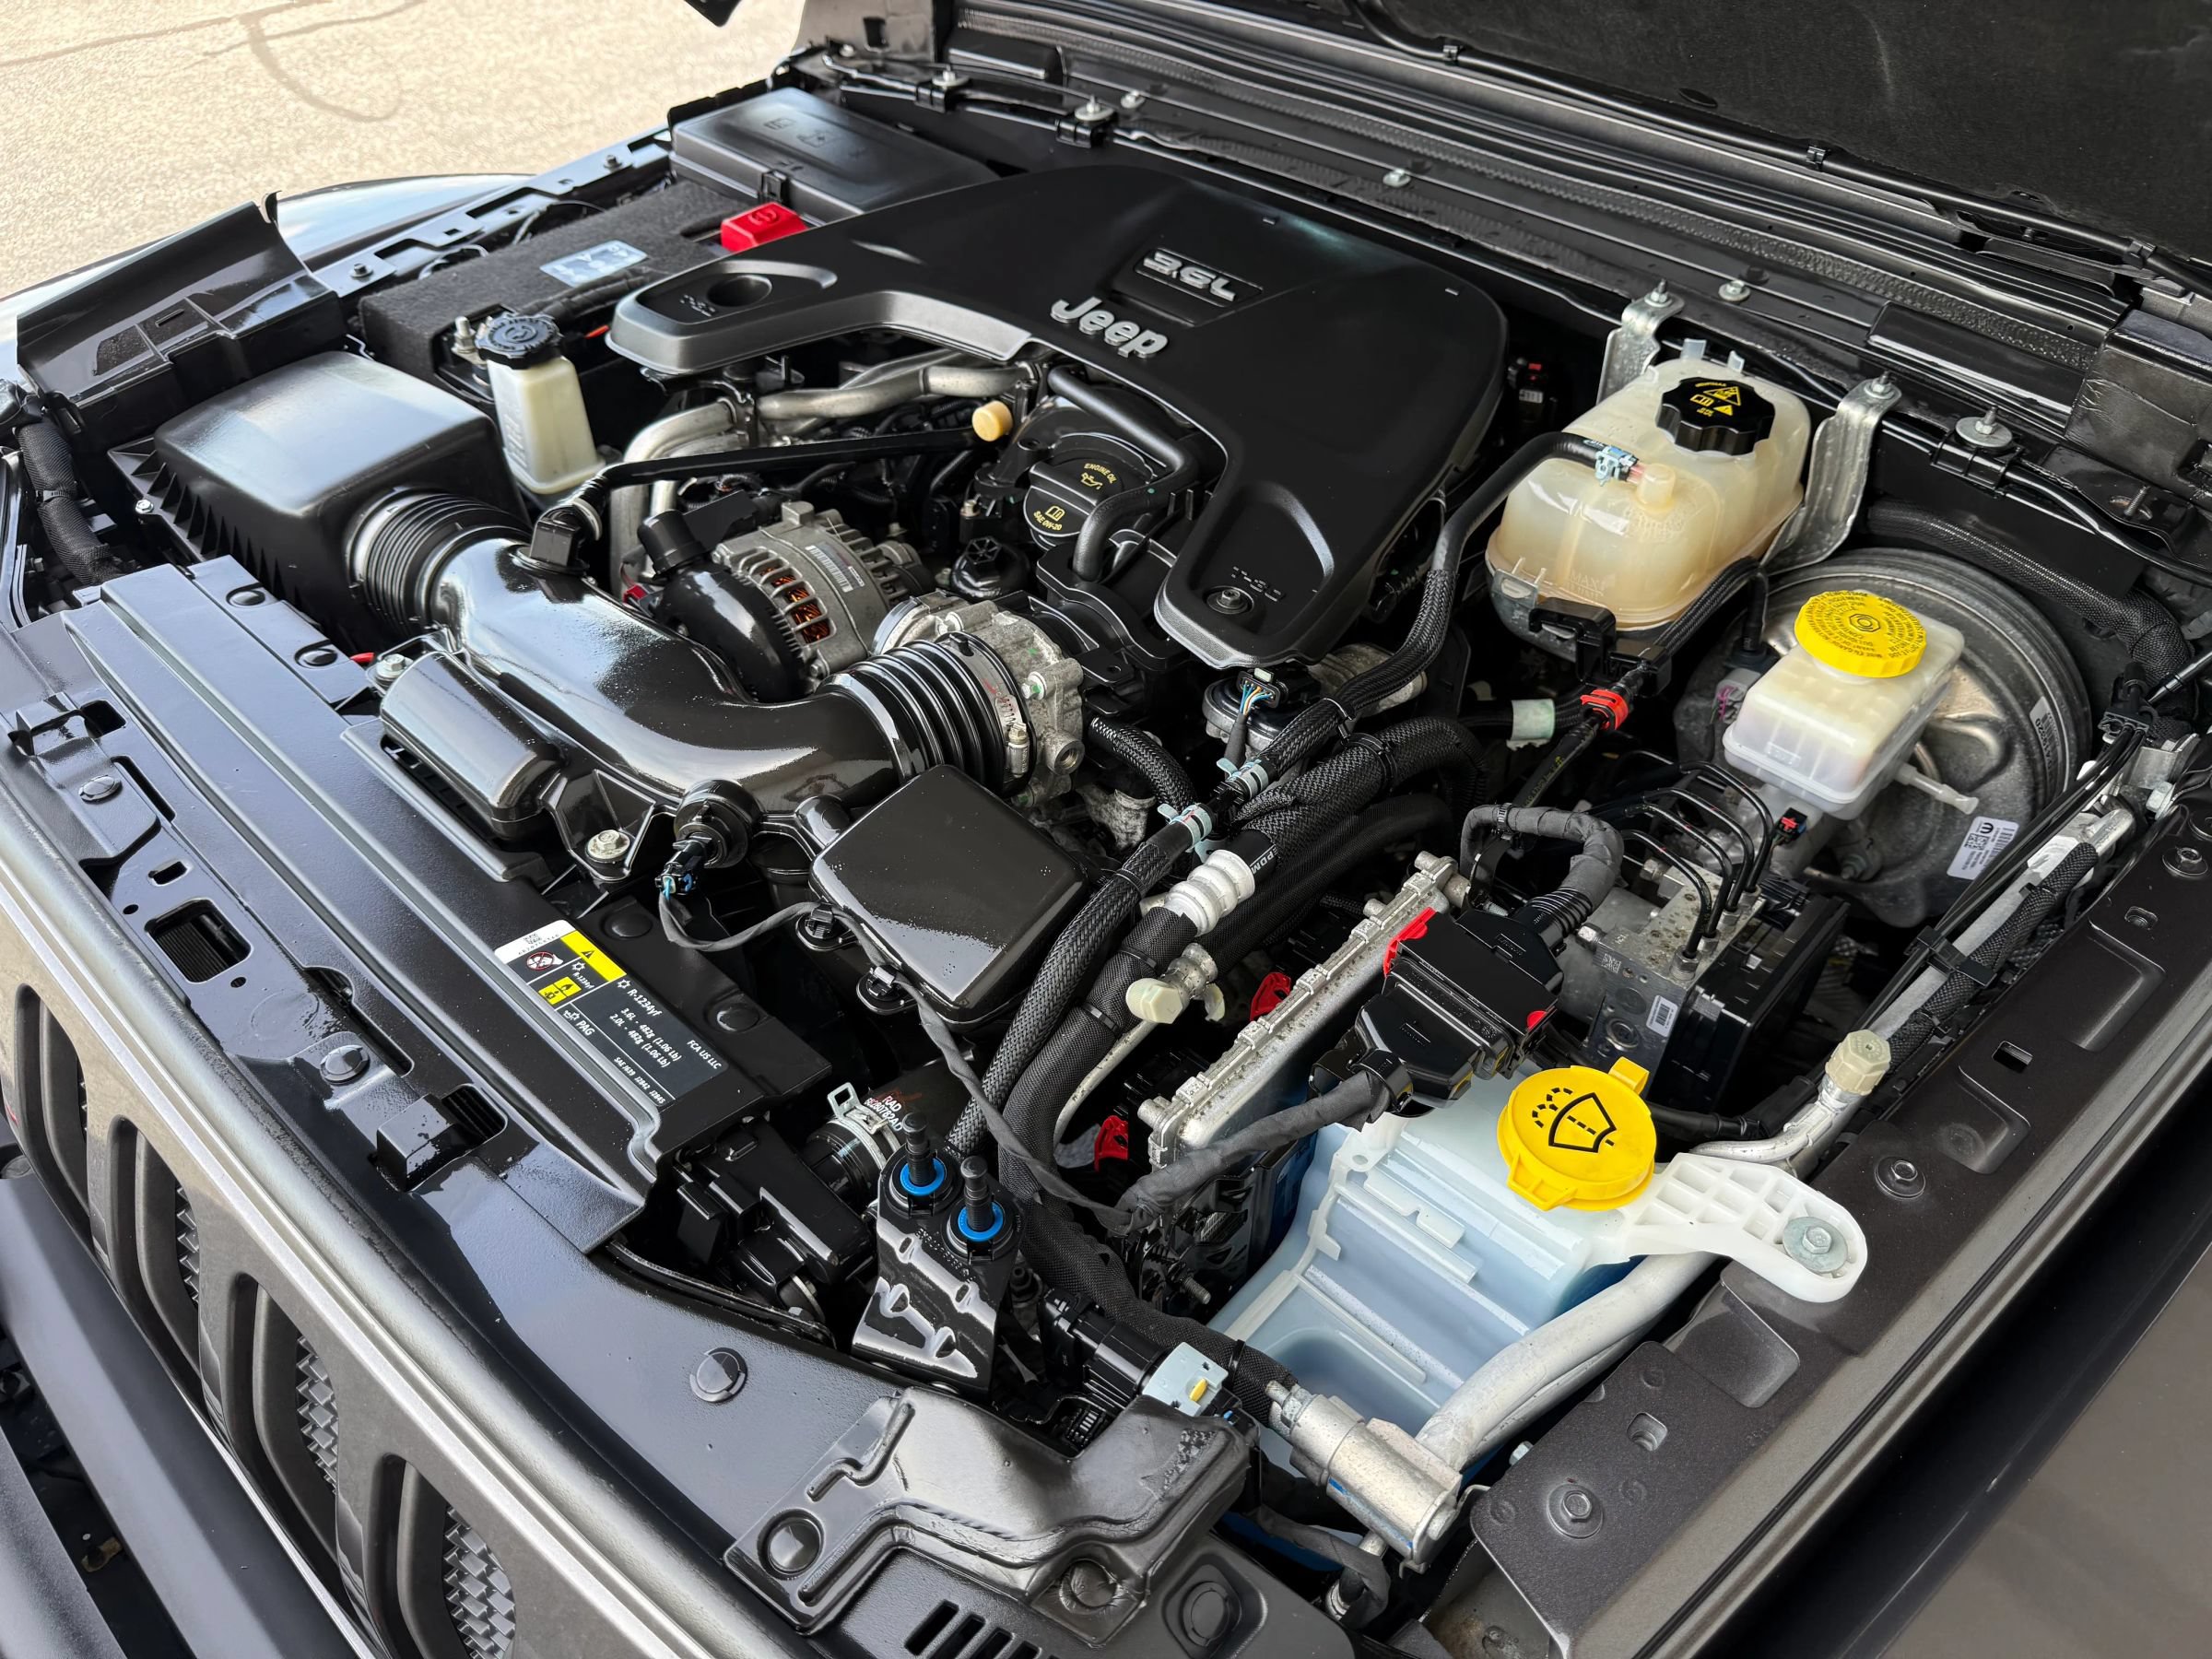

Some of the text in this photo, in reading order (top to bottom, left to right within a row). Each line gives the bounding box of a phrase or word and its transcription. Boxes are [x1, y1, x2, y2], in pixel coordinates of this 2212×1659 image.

[1143, 252, 1237, 301] 3.6L
[1050, 296, 1169, 359] Jeep
[1084, 463, 1117, 484] ENGINE OIL
[1033, 511, 1045, 524] SAE
[627, 988, 663, 1017] R-1234yf
[576, 1019, 595, 1036] PAG
[609, 1013, 625, 1027] 2.0L
[628, 1030, 644, 1045] 482g
[641, 1042, 661, 1059] (1.06
[656, 1055, 671, 1068] Lb)
[620, 1007, 636, 1021] 3.6L
[639, 1024, 655, 1040] 482g
[653, 1037, 672, 1055] (1.06
[668, 1050, 682, 1062] Lb)
[687, 1039, 722, 1069] FCA US LLC
[614, 1056, 627, 1067] SAE
[622, 1065, 636, 1077] J639
[634, 1076, 651, 1090] J2842
[882, 1095, 902, 1112] RAD
